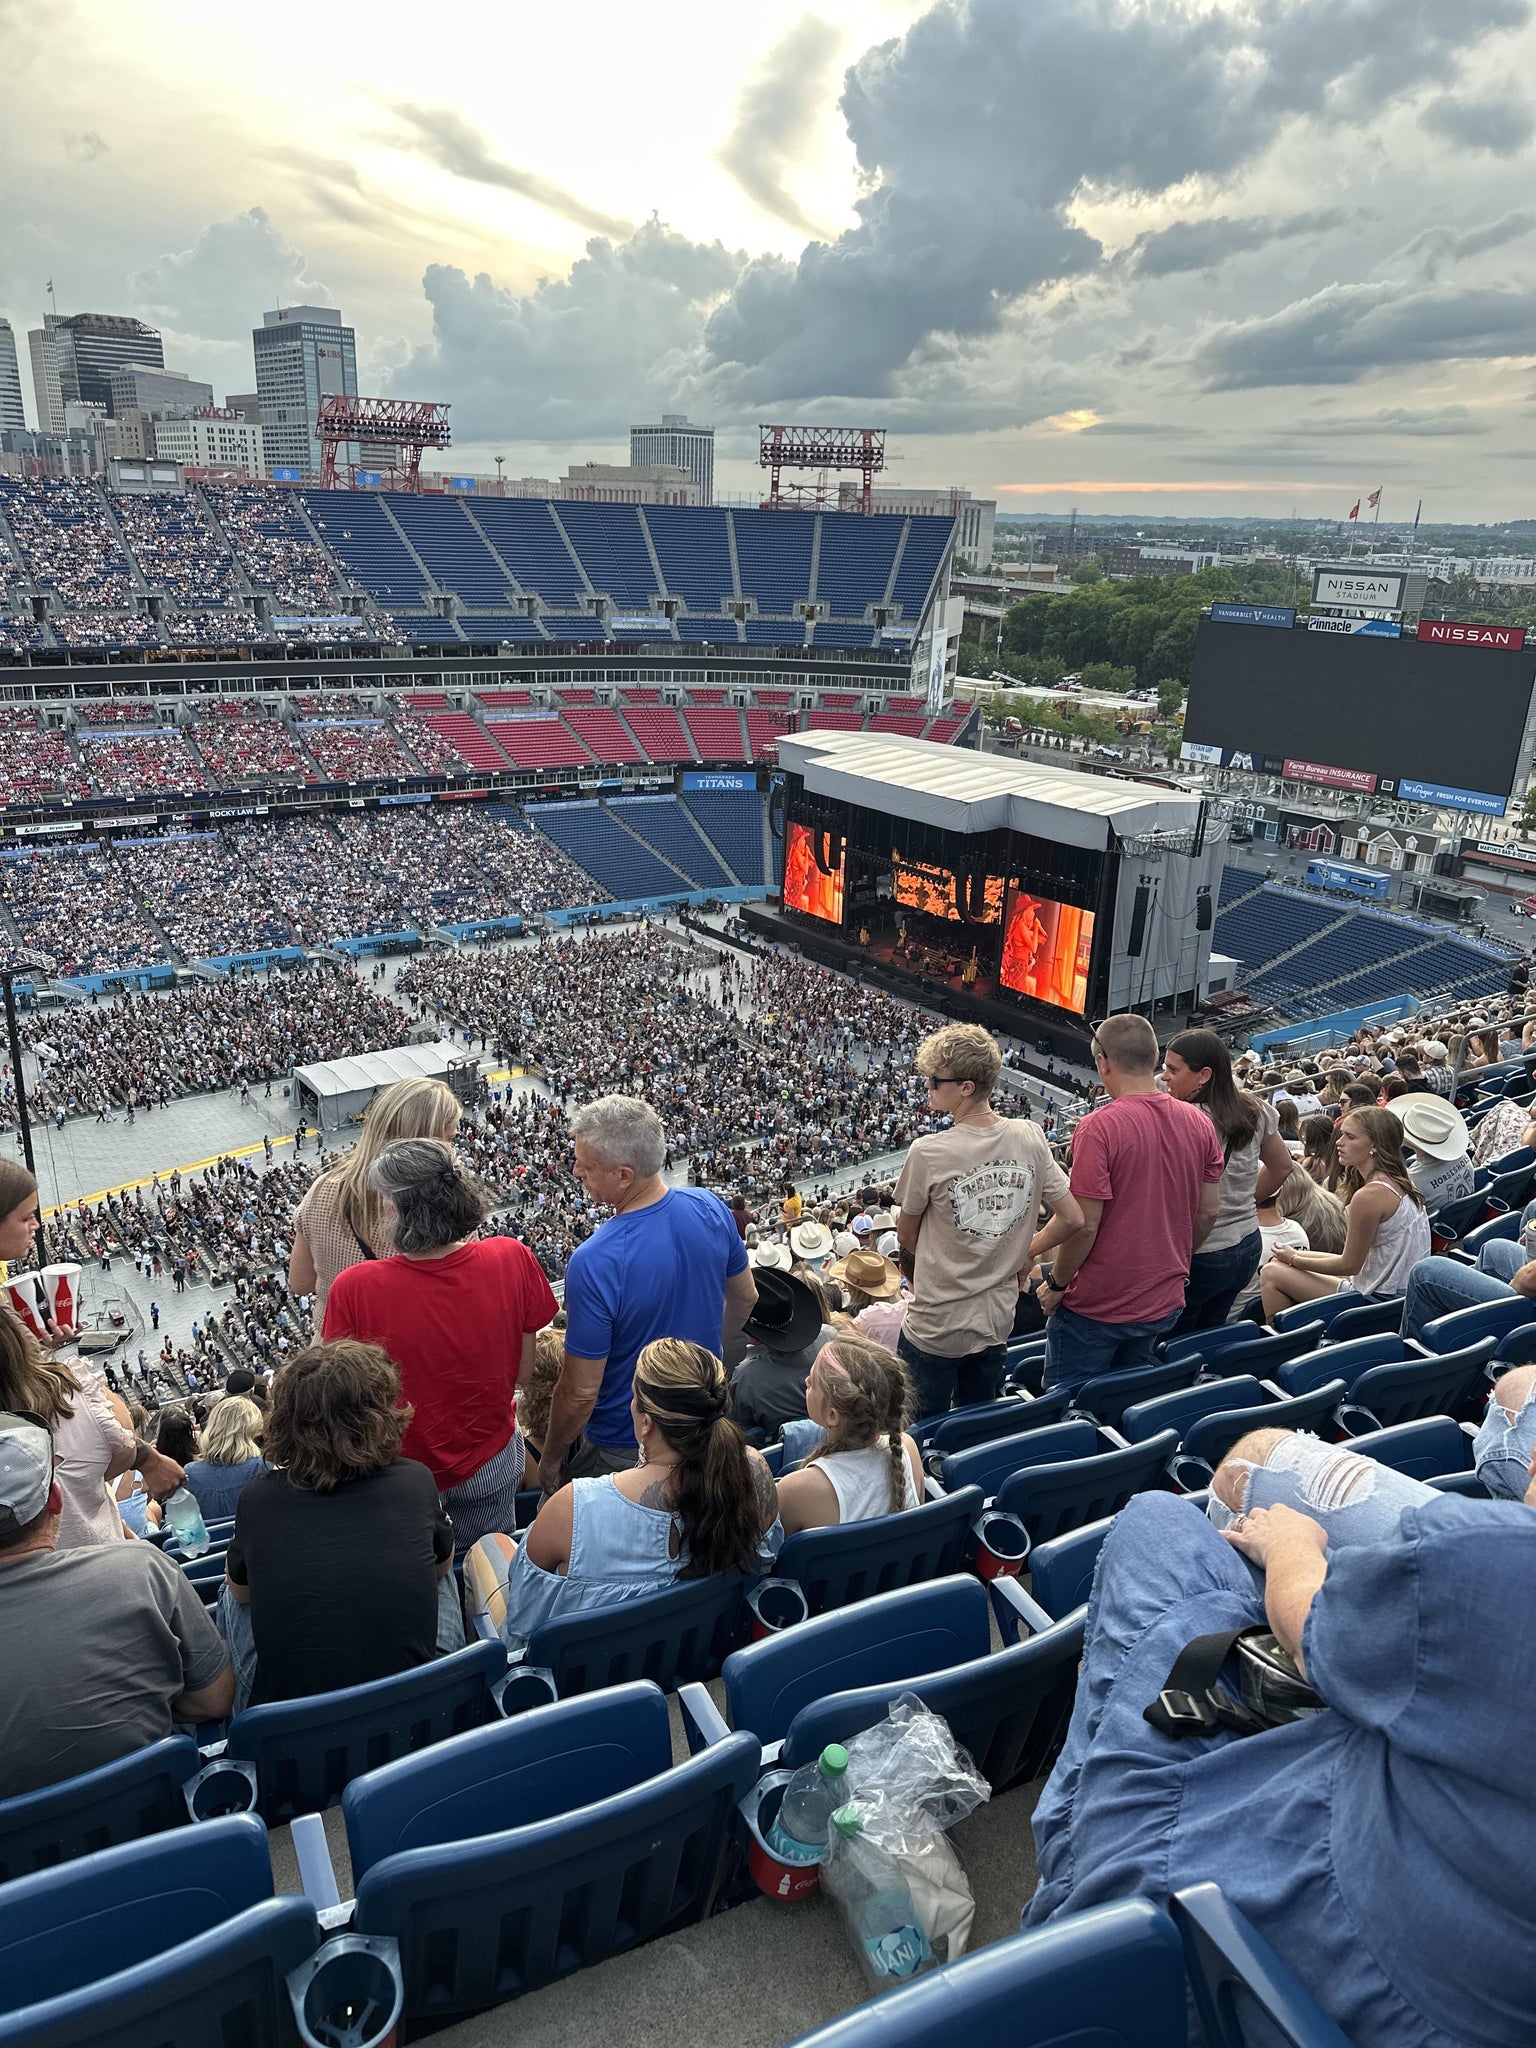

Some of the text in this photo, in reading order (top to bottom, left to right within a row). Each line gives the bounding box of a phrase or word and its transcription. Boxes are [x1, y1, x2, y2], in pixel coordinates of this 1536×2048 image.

[327, 350, 342, 358] UBS
[198, 407, 245, 421] WKDF
[1328, 579, 1389, 592] NISSAN
[1336, 592, 1377, 600] STADIUM
[1218, 610, 1252, 618] VANDERBILT
[1310, 618, 1352, 632] Pinnacle
[1432, 626, 1510, 644] NISSAN
[1190, 744, 1206, 752] TITAN
[1288, 762, 1371, 782] Farm Bureau INSURANCE
[697, 780, 743, 788] TITANS
[1412, 785, 1434, 798] Kroger
[1436, 792, 1454, 801] FRESH
[1480, 844, 1501, 853] MARTIN'S
[1502, 850, 1527, 858] BAR-B-QUE
[978, 1192, 1014, 1214] DUDE
